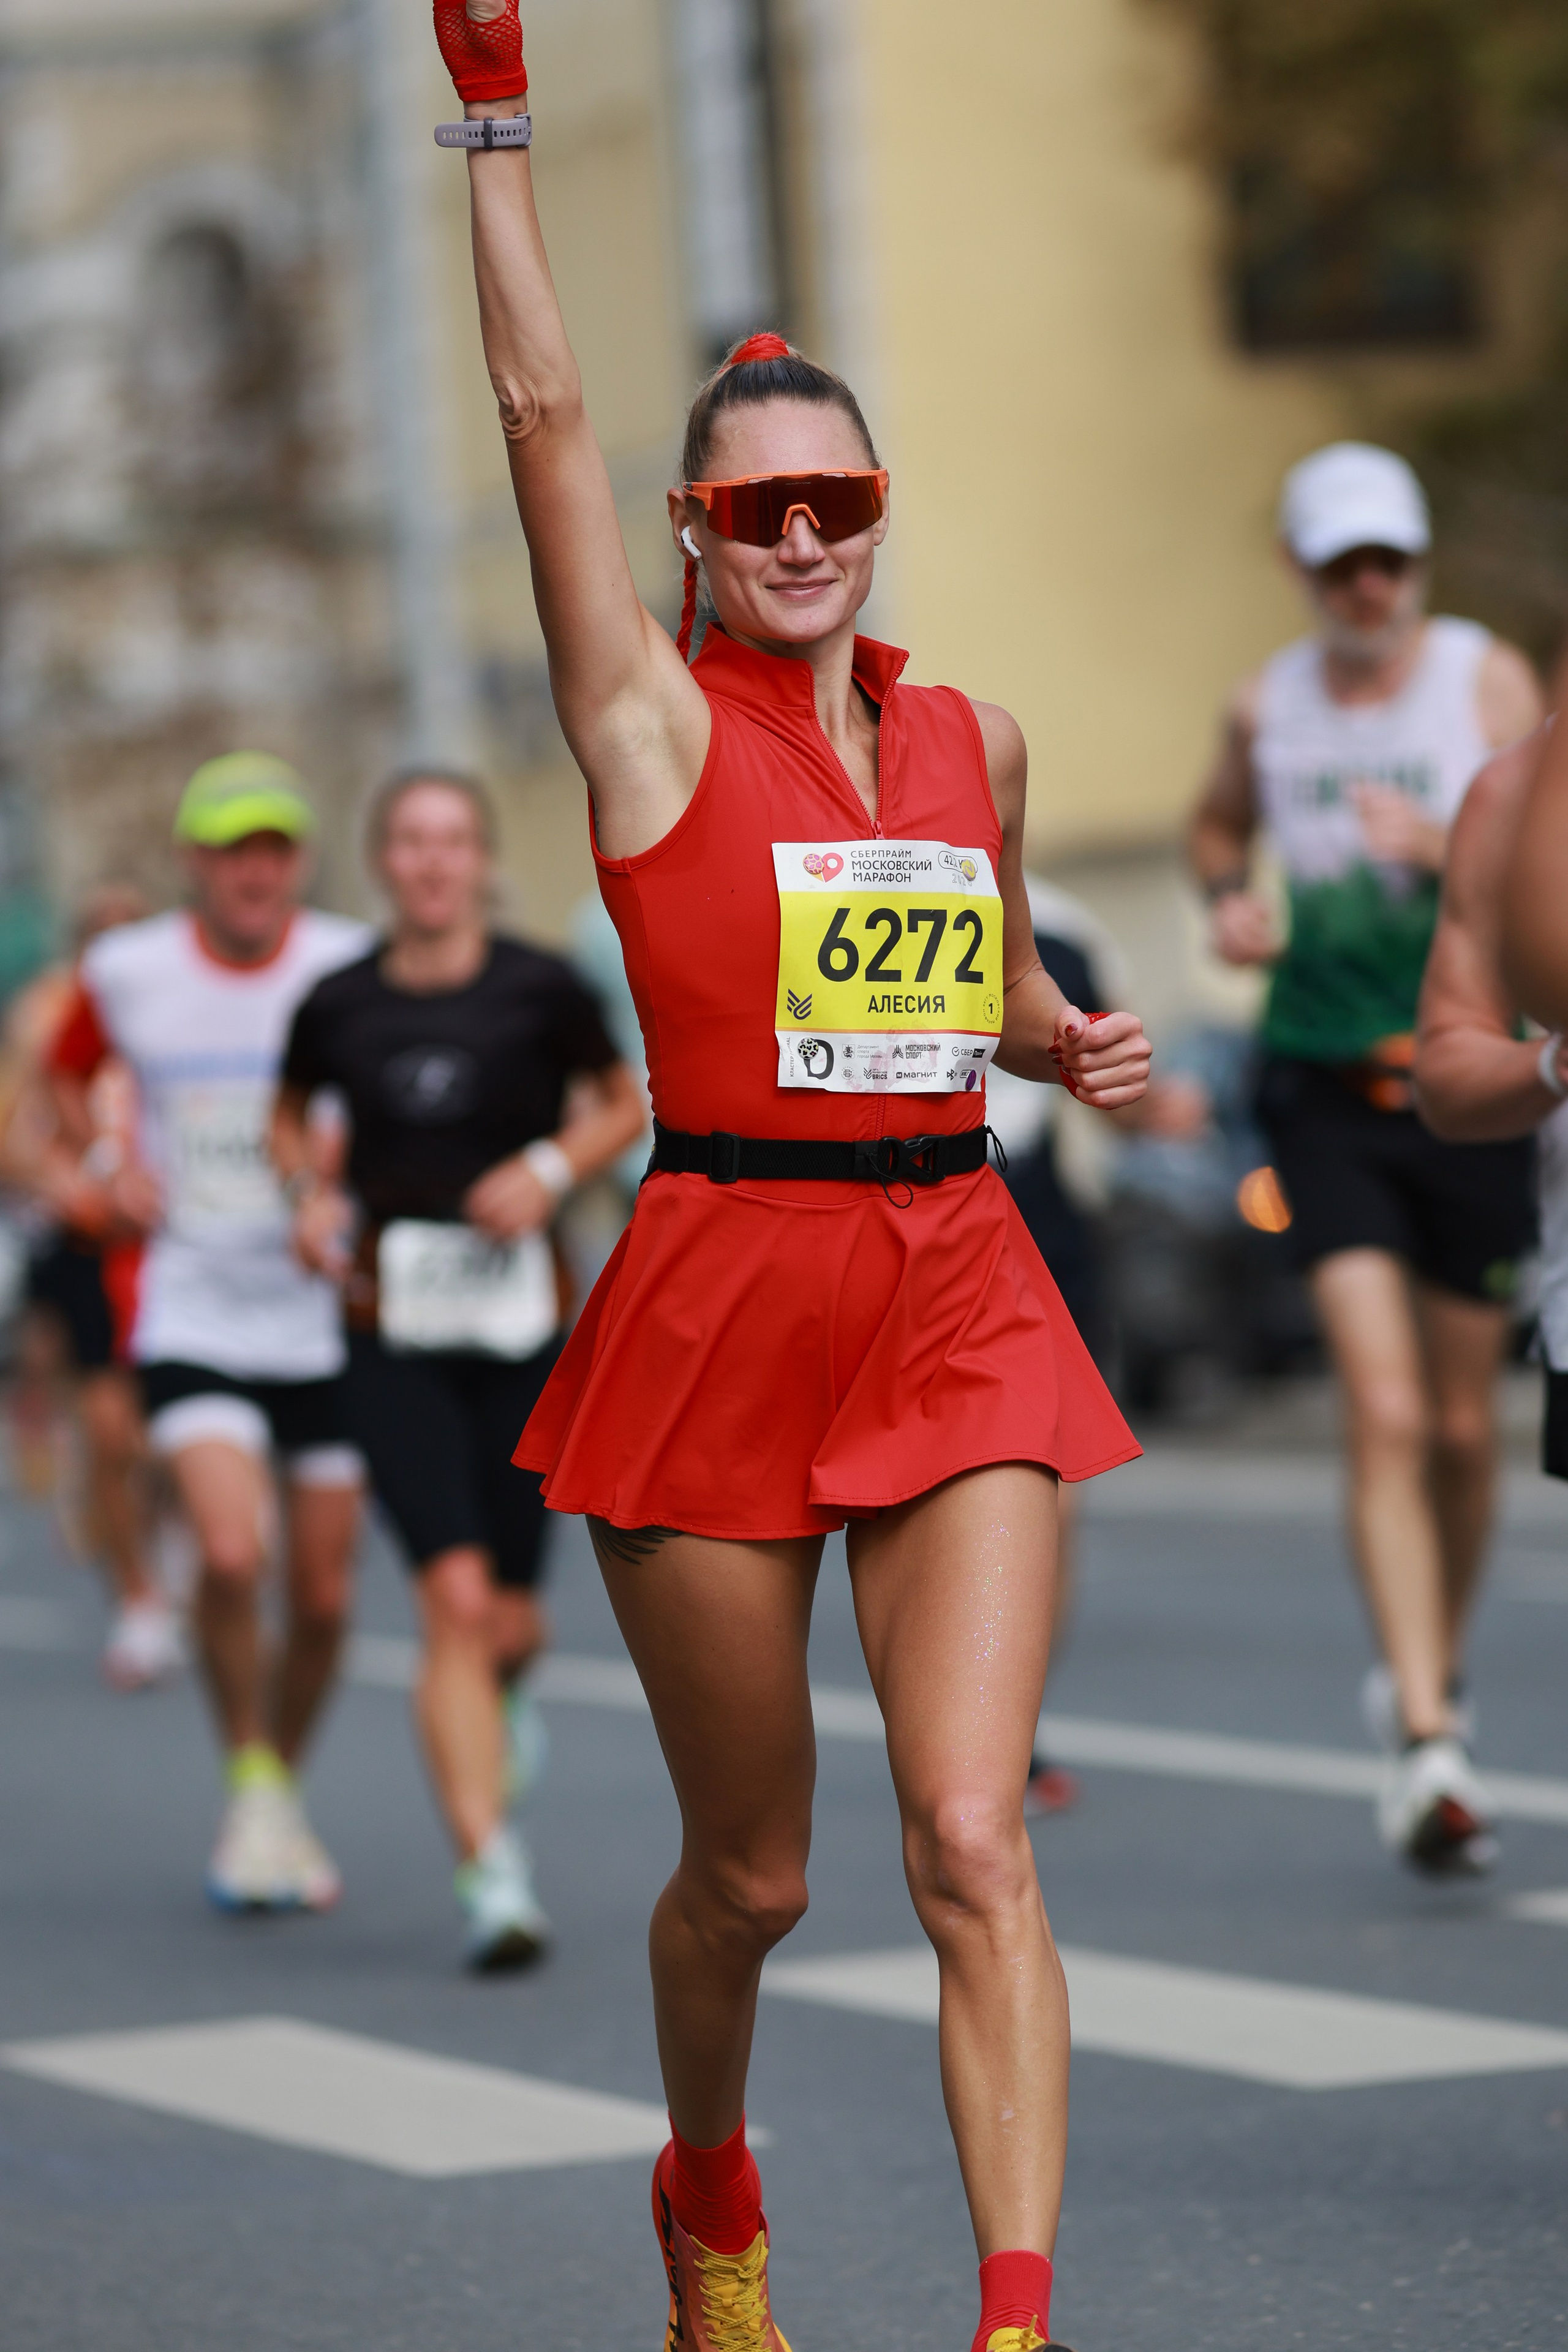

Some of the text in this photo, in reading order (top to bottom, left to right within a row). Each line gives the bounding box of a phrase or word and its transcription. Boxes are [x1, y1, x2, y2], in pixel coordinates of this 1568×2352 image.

[850, 848, 911, 858] СБЕРПРАЙМ
[851, 859, 932, 871] МОСКОВСКИЙ
[853, 872, 911, 883] МАРАФОН
[817, 907, 984, 984] 6272
[867, 995, 946, 1014] АЛЕСИЯ
[988, 1003, 993, 1014] 1
[905, 1042, 941, 1052] МОСКОВСКИЙ
